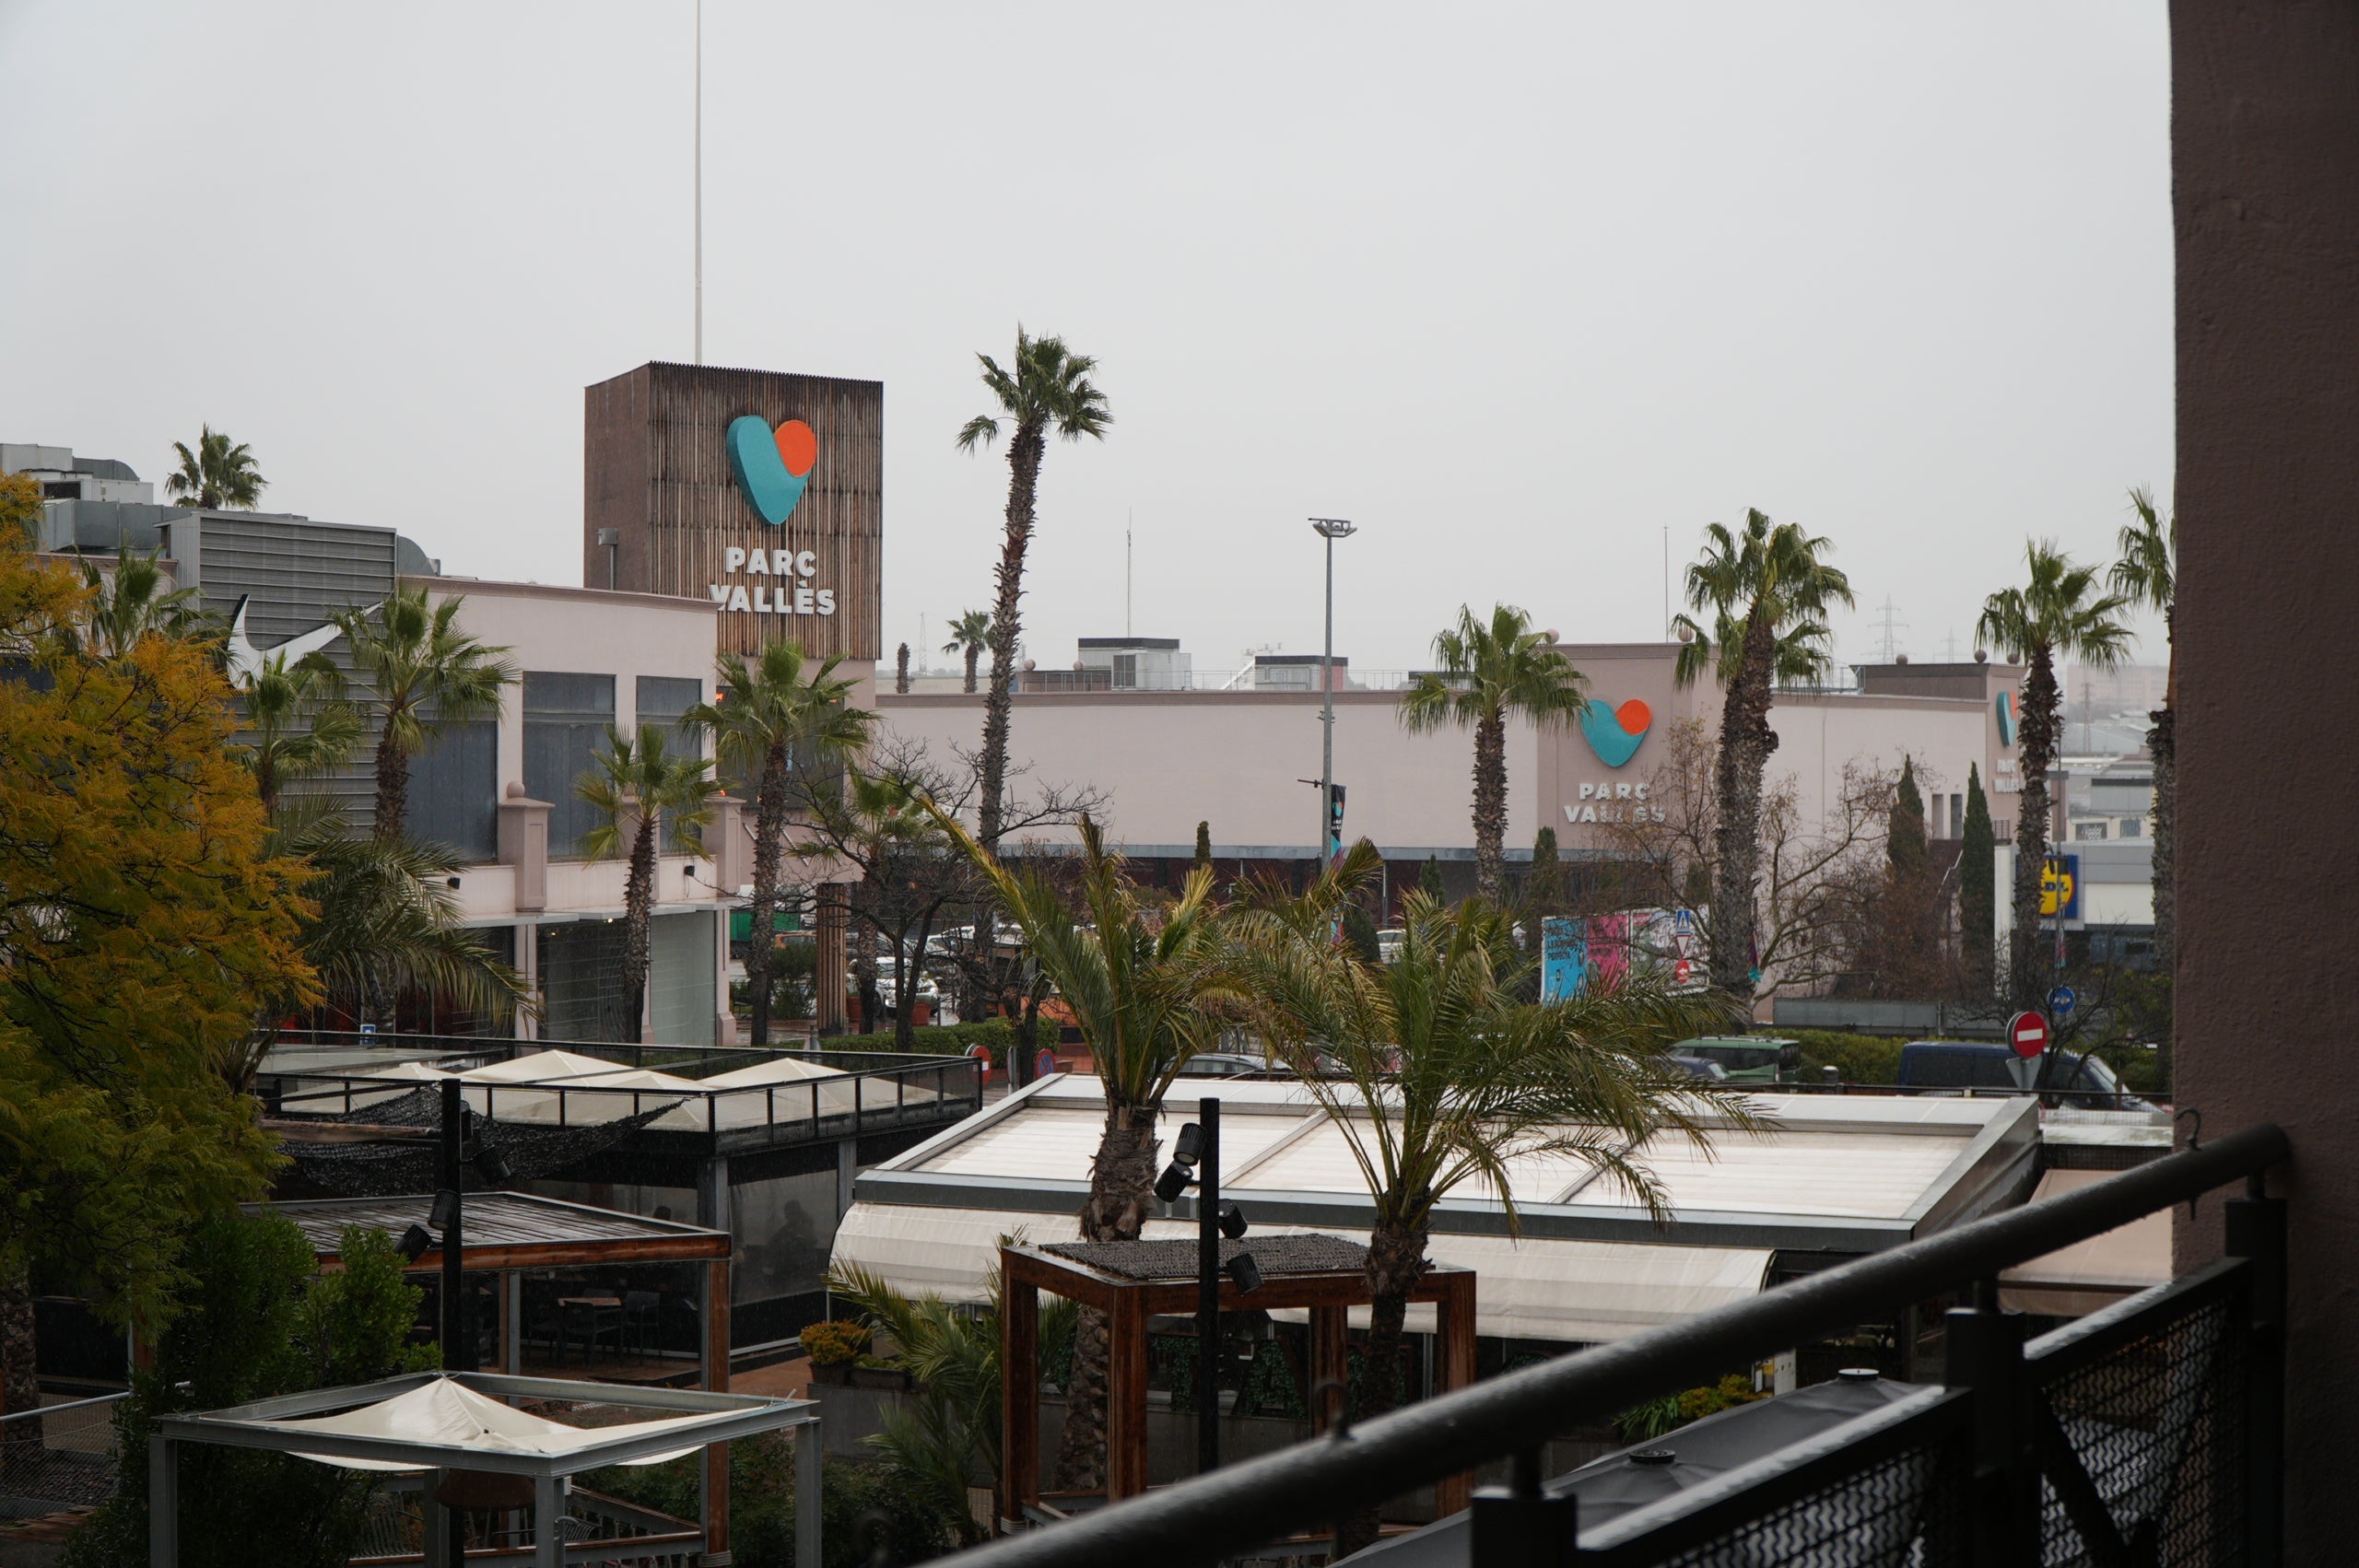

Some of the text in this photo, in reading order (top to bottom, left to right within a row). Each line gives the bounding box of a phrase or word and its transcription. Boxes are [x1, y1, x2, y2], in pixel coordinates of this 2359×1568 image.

[725, 546, 816, 578] PARC
[709, 579, 836, 615] VALLÈS
[1579, 782, 1649, 801] PARC
